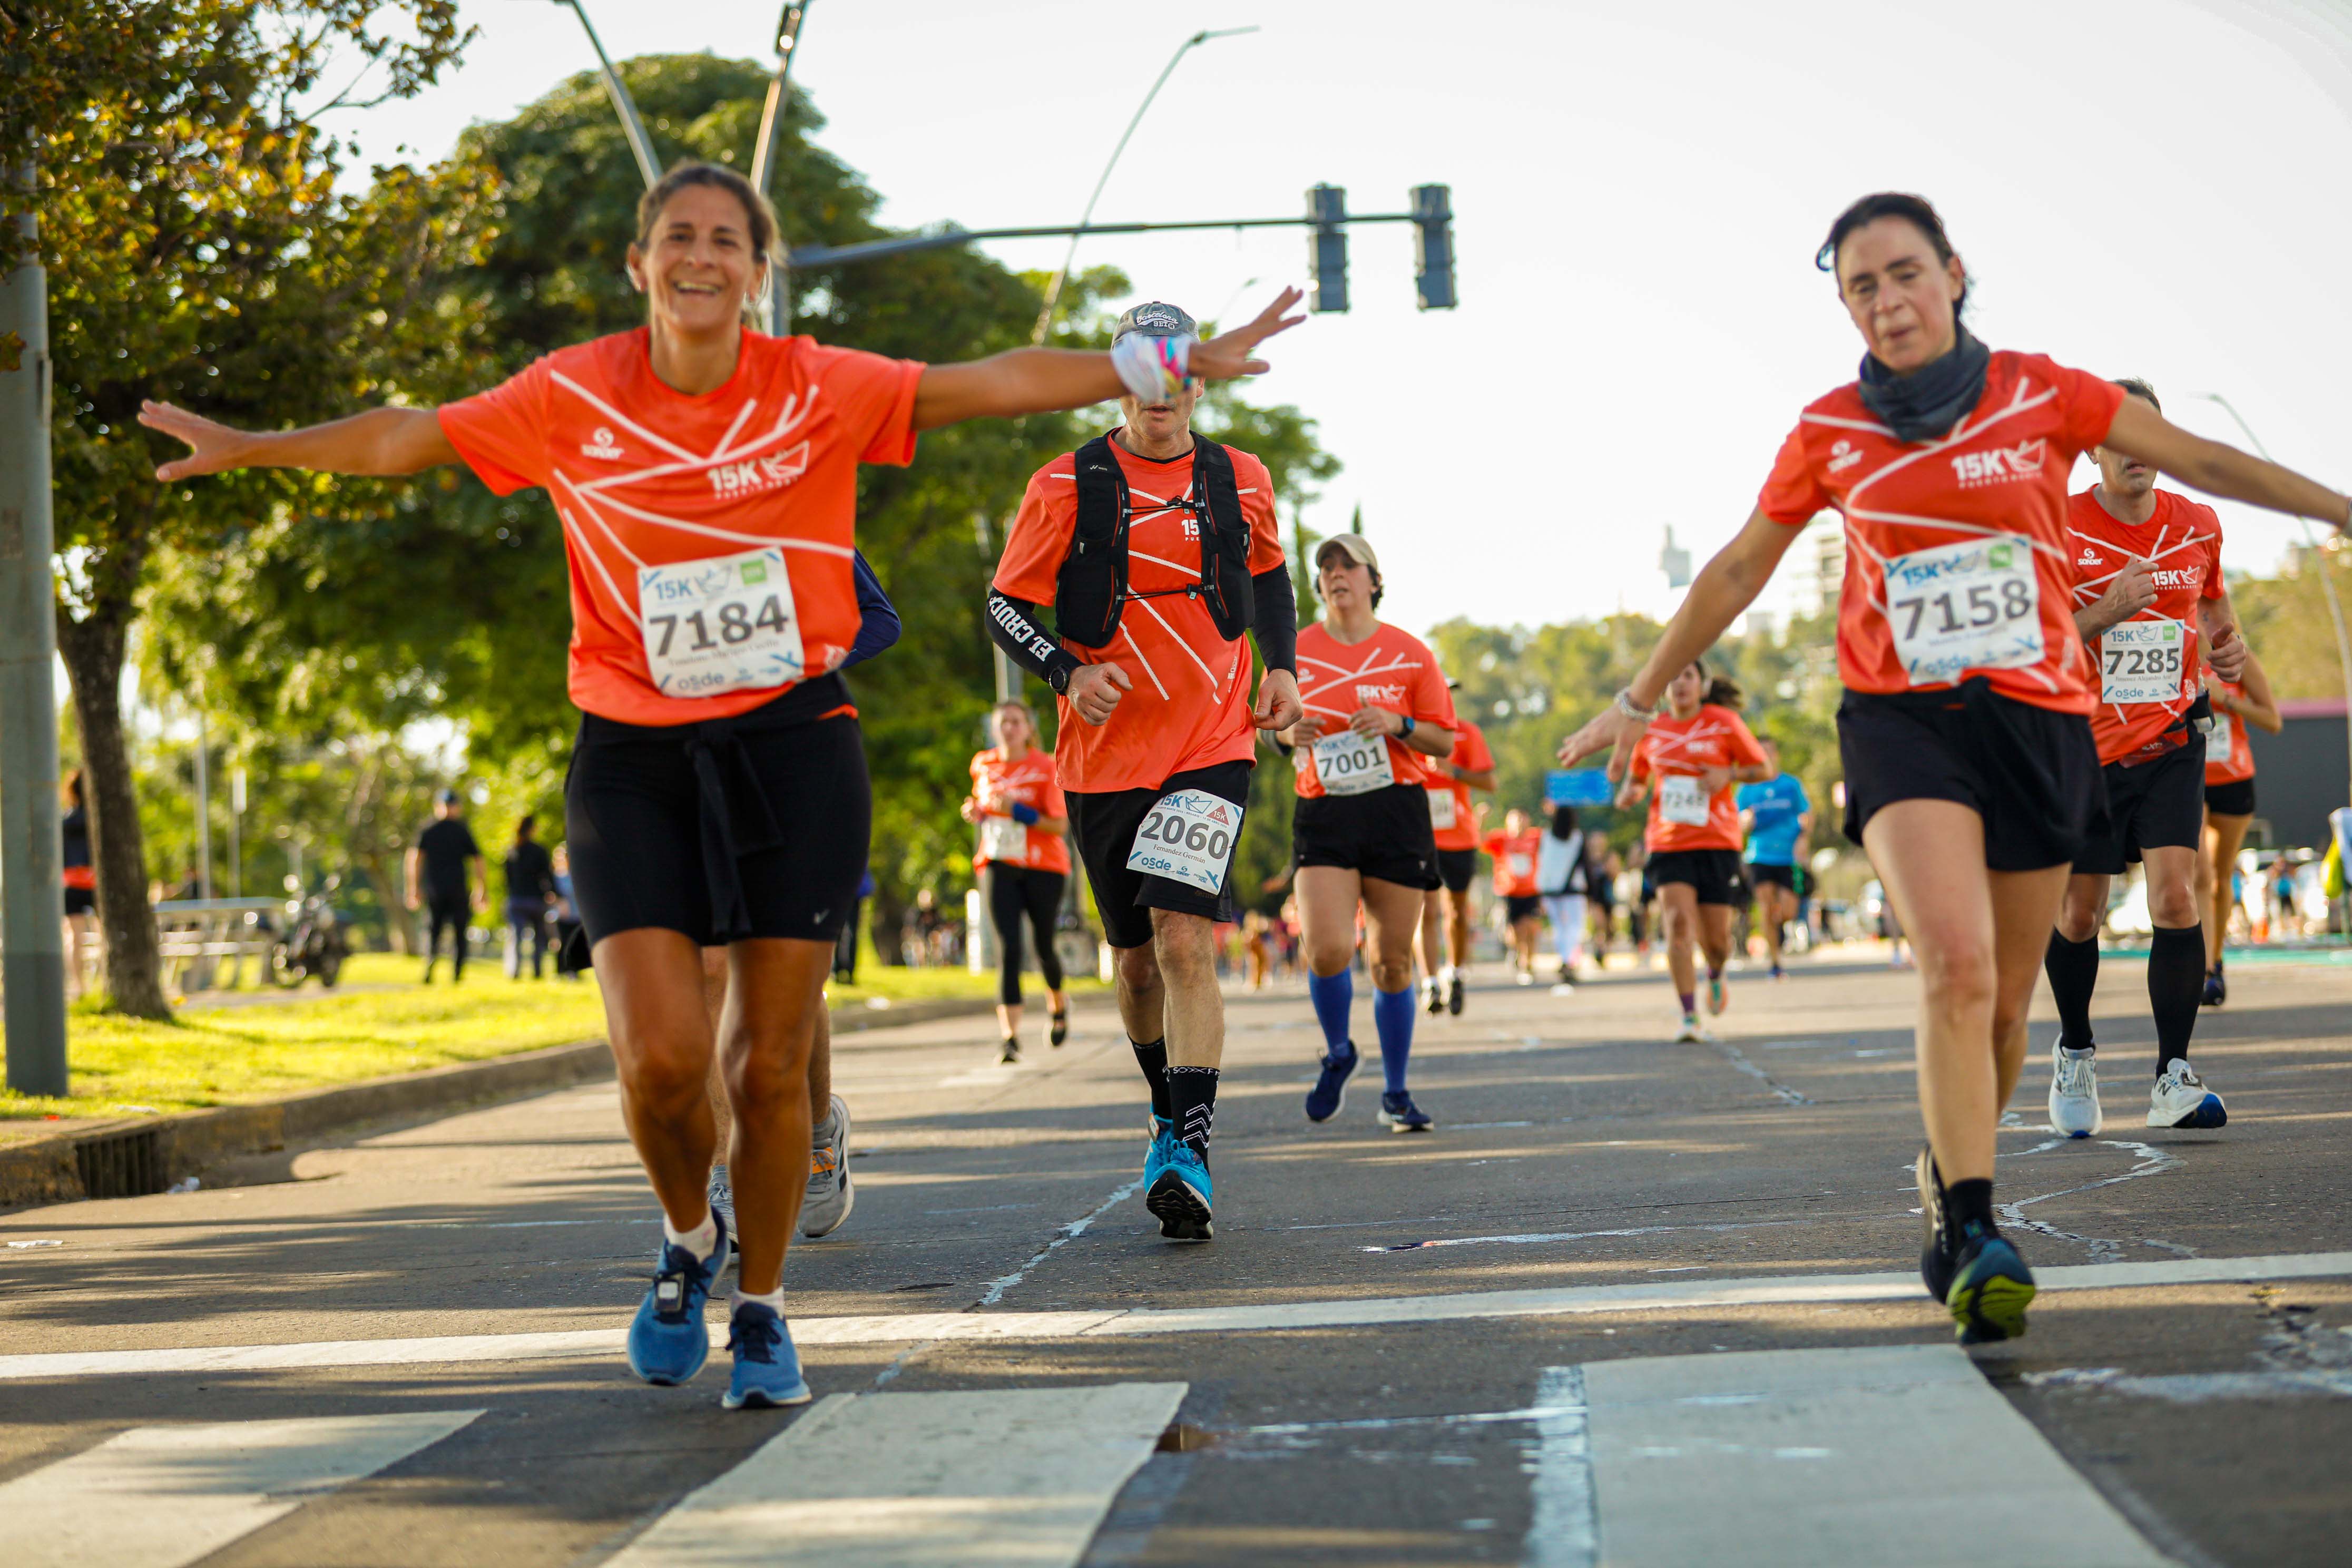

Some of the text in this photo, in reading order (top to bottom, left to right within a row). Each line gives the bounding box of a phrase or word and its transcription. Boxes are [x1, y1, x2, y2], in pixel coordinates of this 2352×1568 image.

[1136, 310, 1178, 323] Barcelona
[708, 459, 762, 491] 15K
[1951, 449, 2006, 481] 15K
[1181, 519, 1200, 535] 15
[1902, 562, 1939, 586] 15K
[2151, 570, 2180, 586] 15K
[655, 578, 693, 600] 15K
[1896, 579, 2031, 641] 7158
[649, 594, 789, 657] 7184
[2111, 630, 2134, 642] 15K
[1028, 635, 1056, 662] EL
[2105, 648, 2179, 674] 7285
[677, 671, 724, 691] osde
[2115, 688, 2144, 699] osde
[1319, 745, 1386, 778] 7001
[1160, 795, 1184, 808] 15K
[1213, 810, 1227, 821] 15K
[1141, 811, 1229, 859] 2060
[1141, 857, 1171, 870] osde
[1153, 844, 1206, 864] Fernandez Germán
